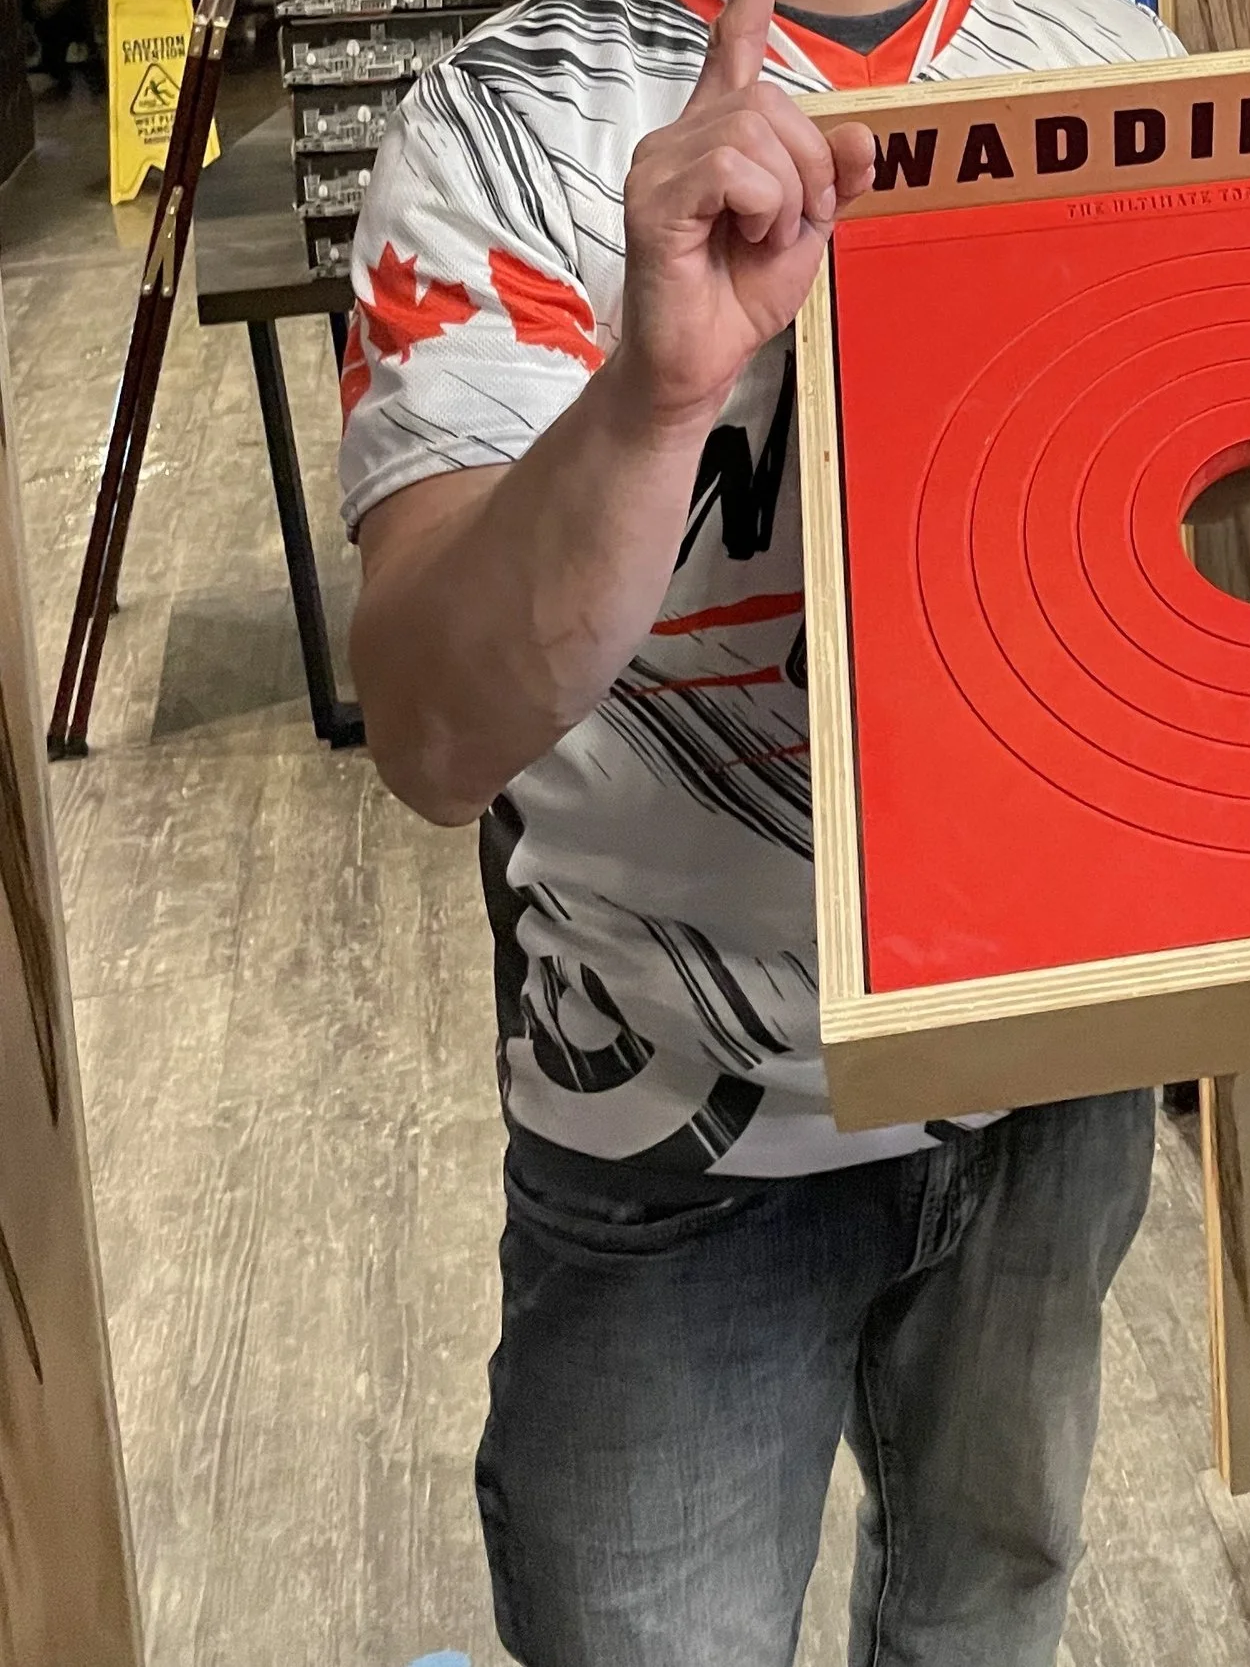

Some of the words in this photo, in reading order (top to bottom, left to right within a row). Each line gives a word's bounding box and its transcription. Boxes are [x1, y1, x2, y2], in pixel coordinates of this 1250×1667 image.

[122, 35, 185, 53] CAUTION
[1067, 203, 1105, 220] THE
[1113, 189, 1212, 214] ULTIMATE
